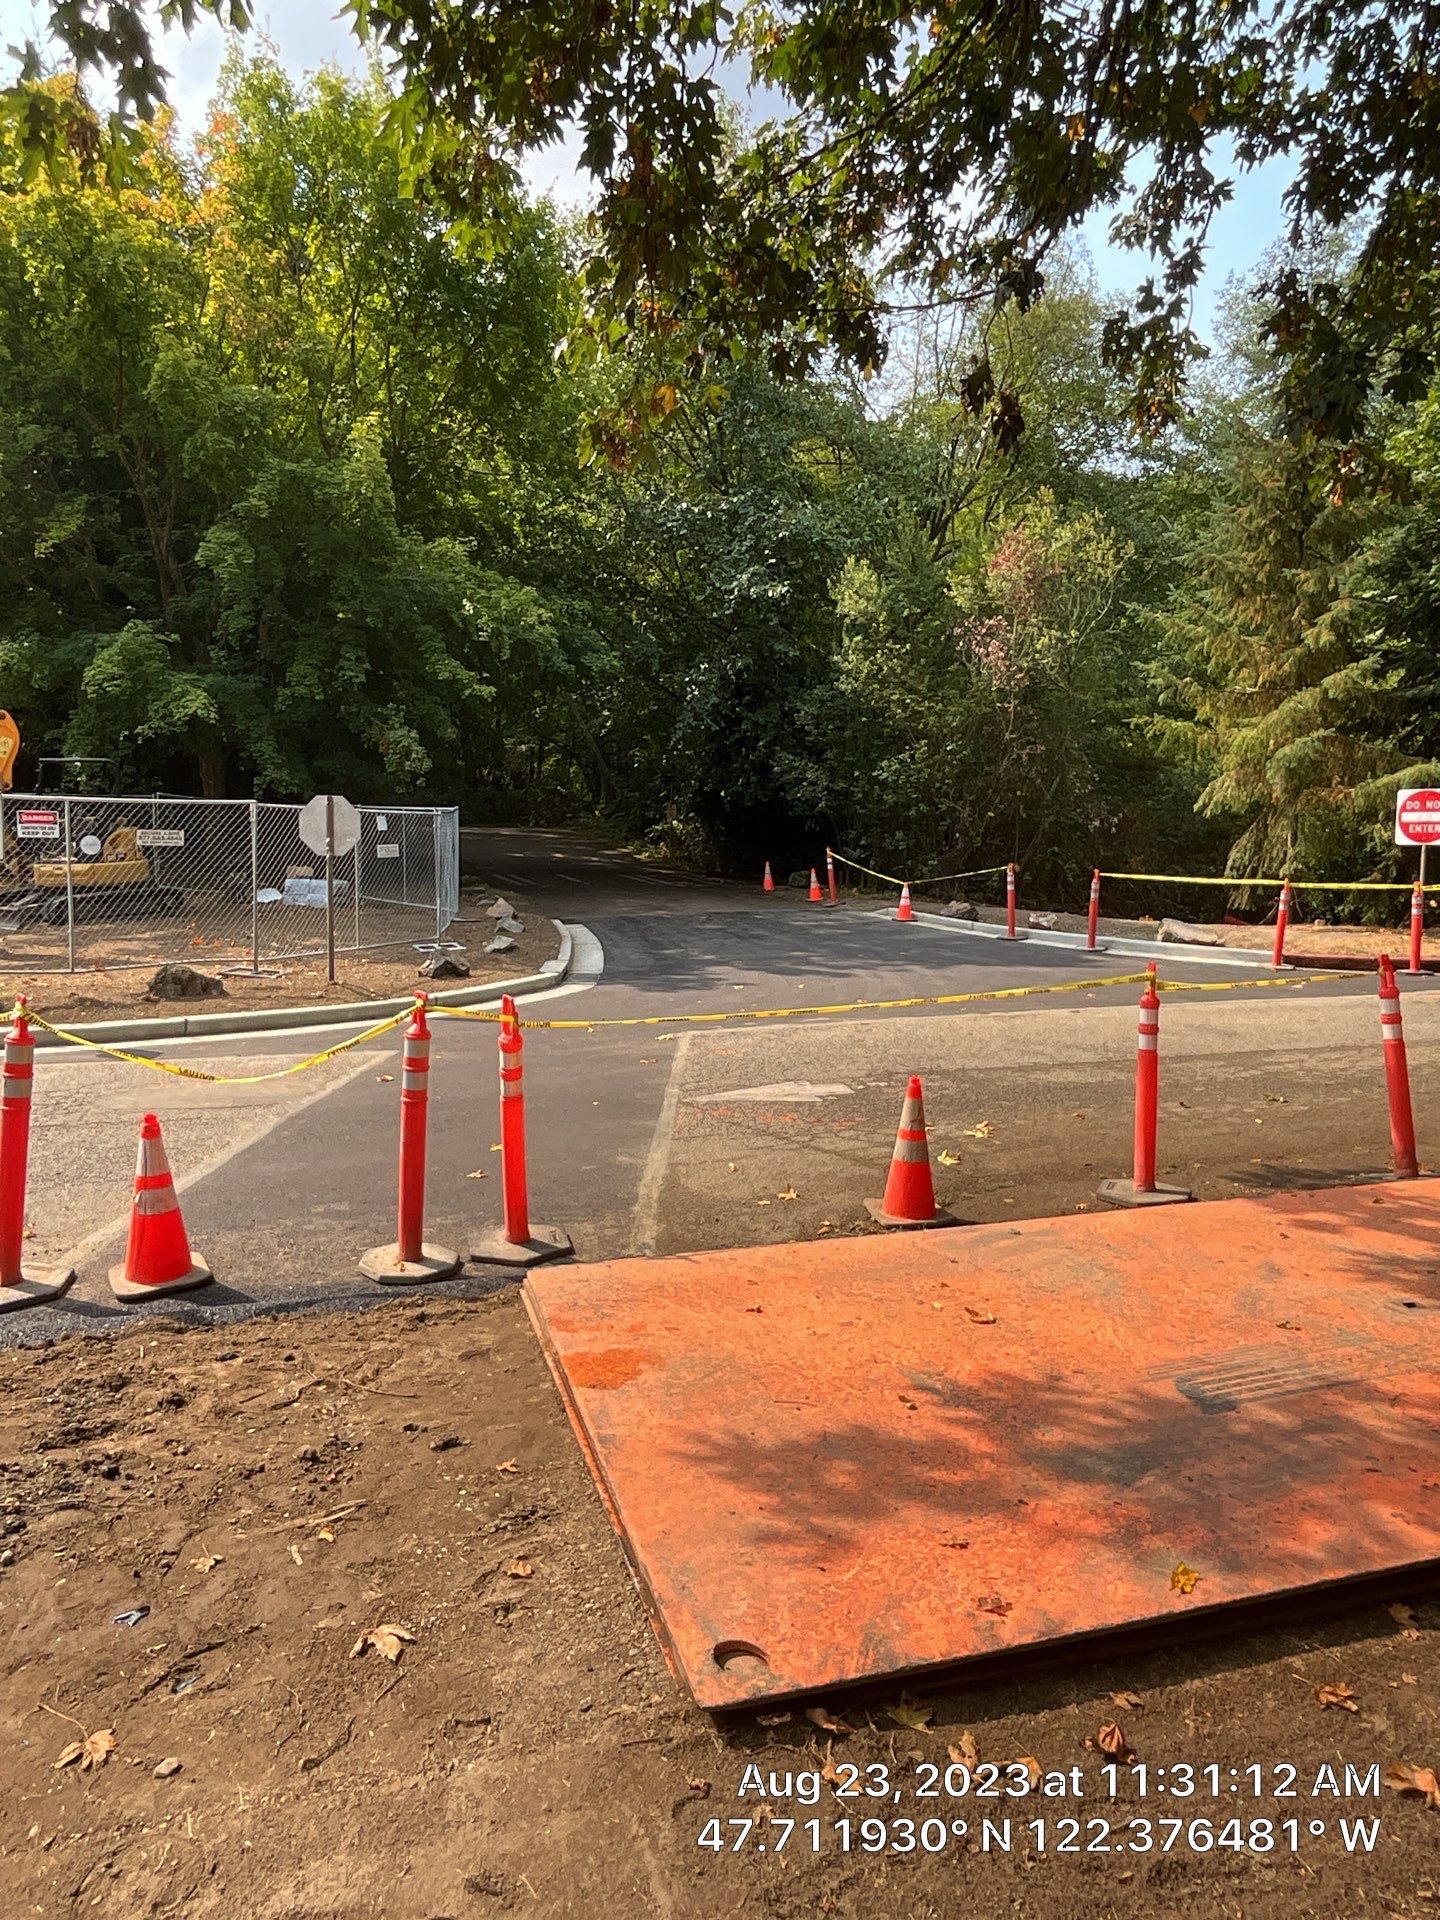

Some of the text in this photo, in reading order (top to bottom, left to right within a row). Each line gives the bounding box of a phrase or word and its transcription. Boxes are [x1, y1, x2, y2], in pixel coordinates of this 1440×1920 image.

[1406, 800, 1440, 810] DO NO
[21, 814, 54, 822] DANGER
